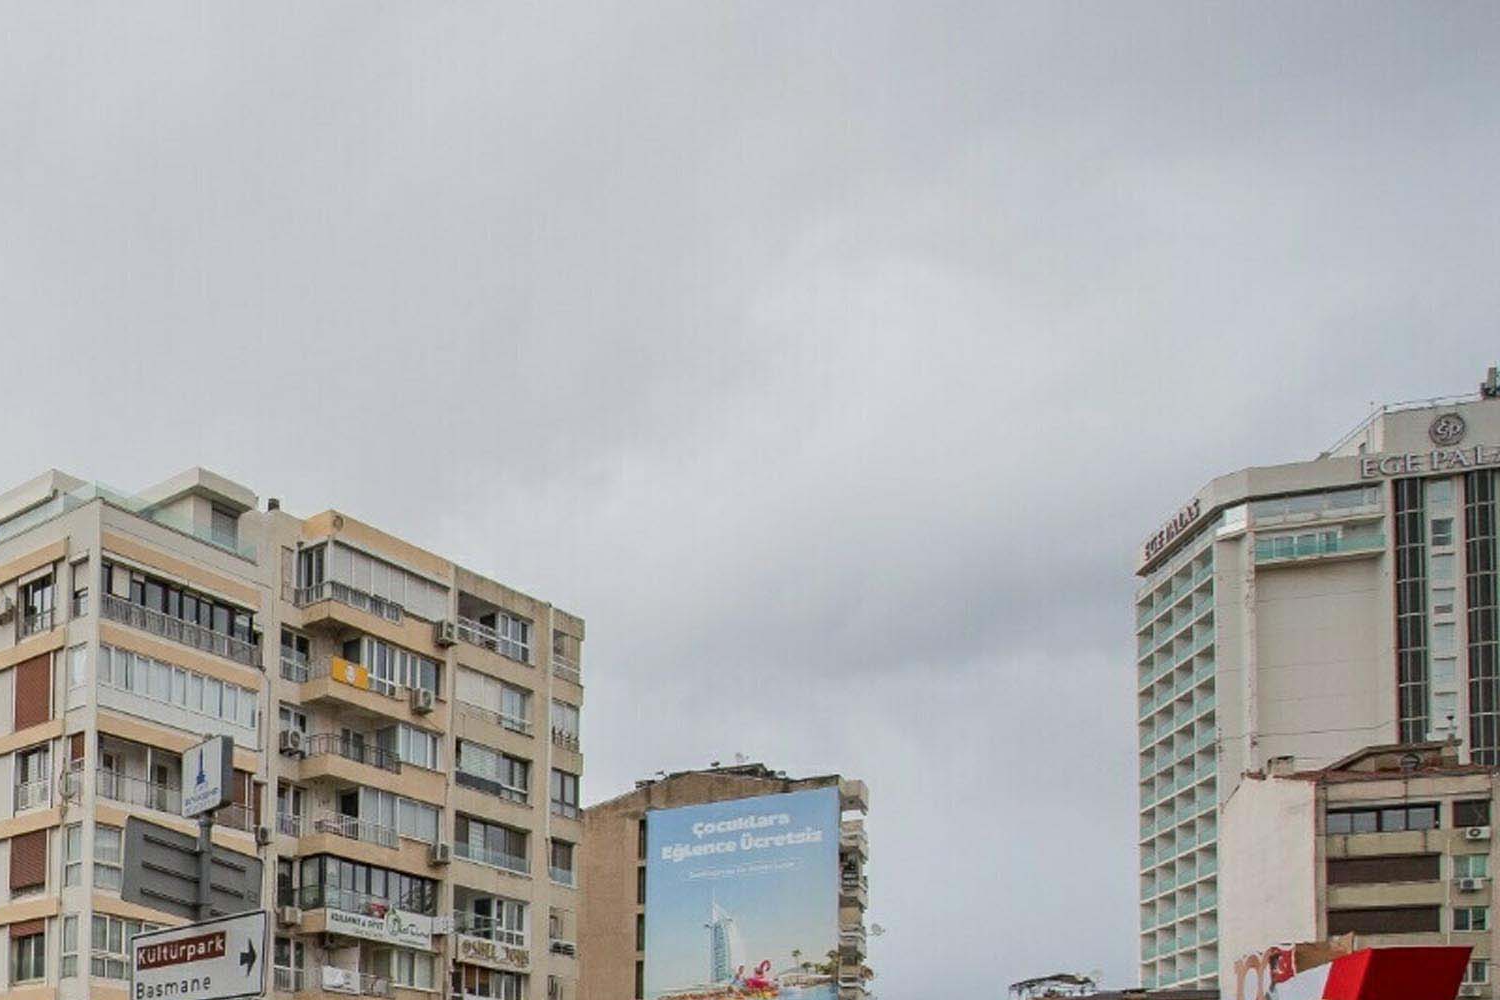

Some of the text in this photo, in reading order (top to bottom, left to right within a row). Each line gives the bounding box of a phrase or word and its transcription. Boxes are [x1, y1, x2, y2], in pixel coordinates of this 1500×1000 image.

[1361, 452, 1424, 479] EGE
[692, 812, 791, 839] Çocuklara
[739, 827, 823, 851] Ücretsiz
[138, 936, 224, 965] Kültürpark
[136, 976, 212, 1000] Basmane
